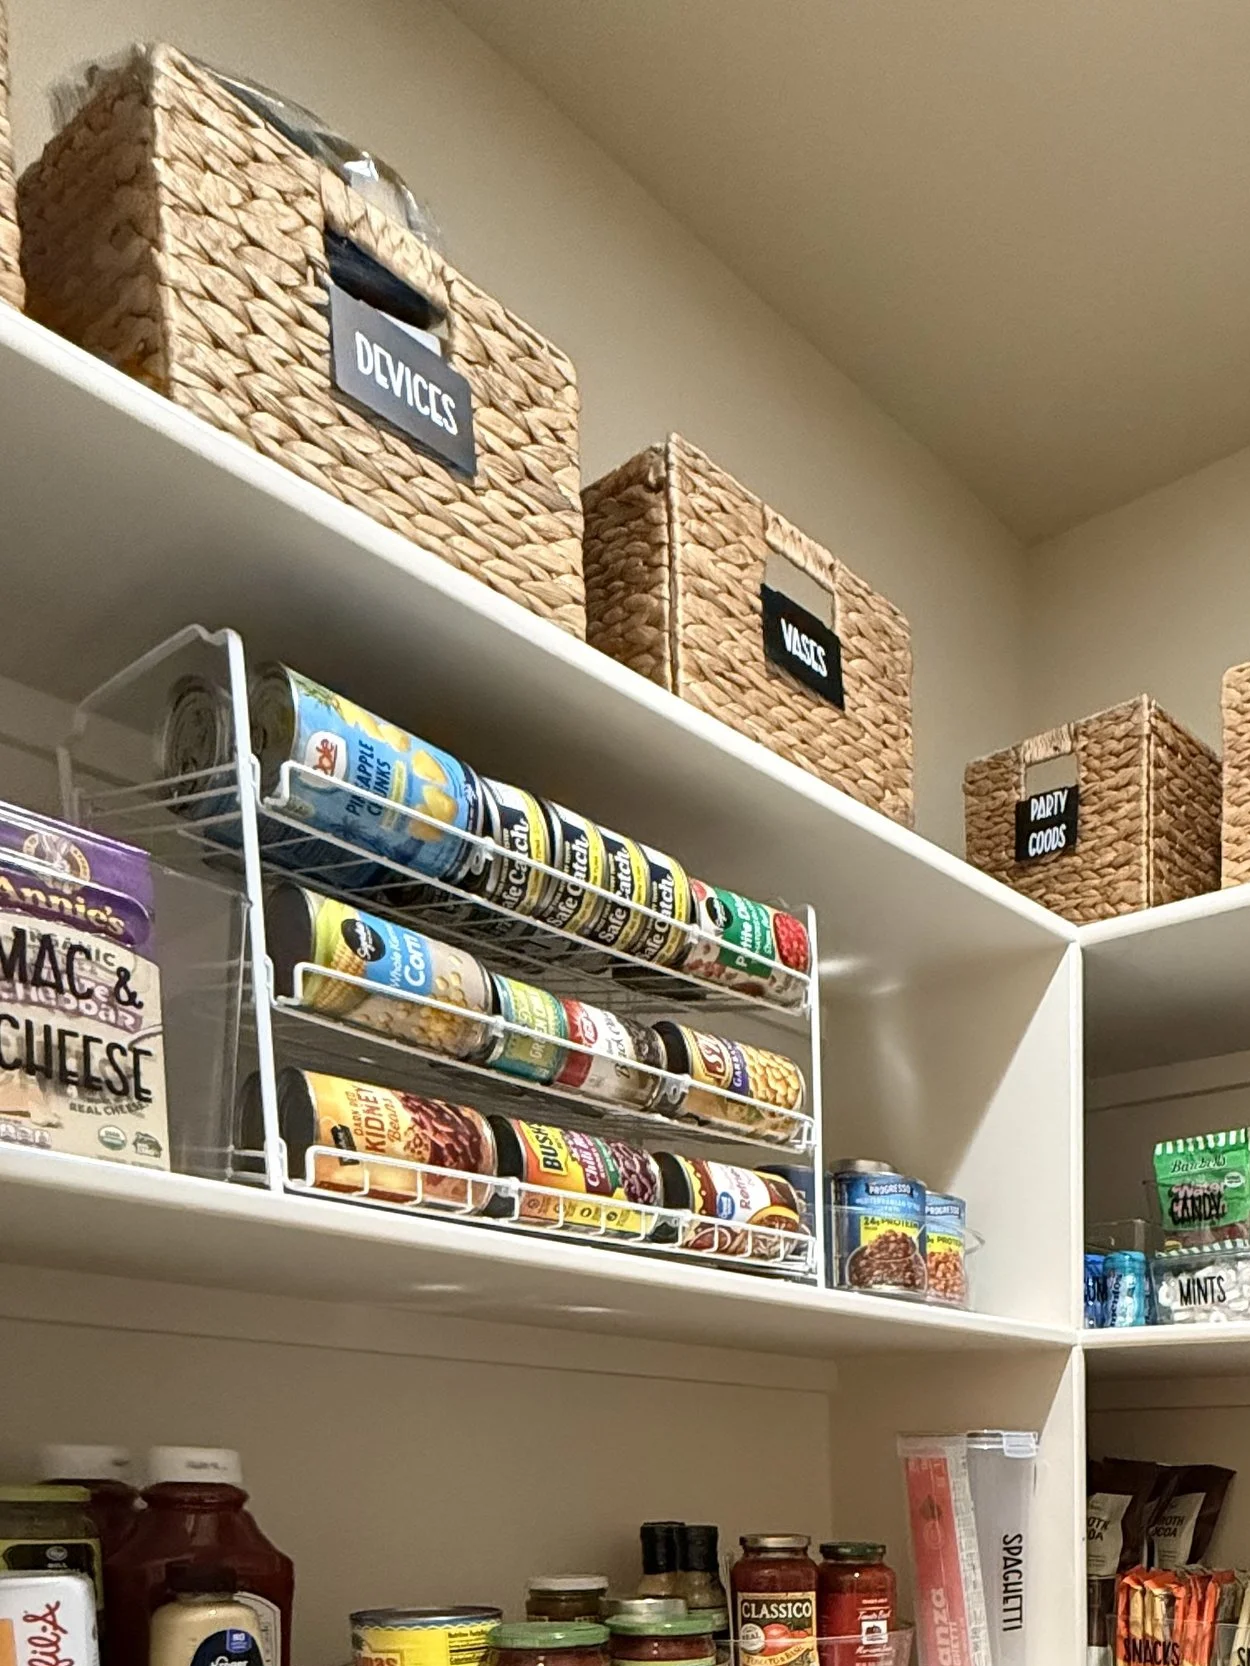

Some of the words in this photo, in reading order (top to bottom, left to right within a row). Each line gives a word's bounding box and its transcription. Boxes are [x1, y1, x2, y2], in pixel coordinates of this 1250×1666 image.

[354, 330, 458, 436] DEVICES
[780, 616, 828, 679] VASES
[1030, 787, 1070, 822] PARTY
[1028, 823, 1067, 857] GOODS
[0, 926, 94, 1001] MAC
[113, 964, 144, 1010] &
[401, 932, 427, 989] Corn
[0, 1012, 154, 1104] CHEESE
[1178, 1276, 1227, 1306] MINTS
[741, 1601, 813, 1620] CLASSICO
[1002, 1533, 1024, 1633] SPAGHETTI
